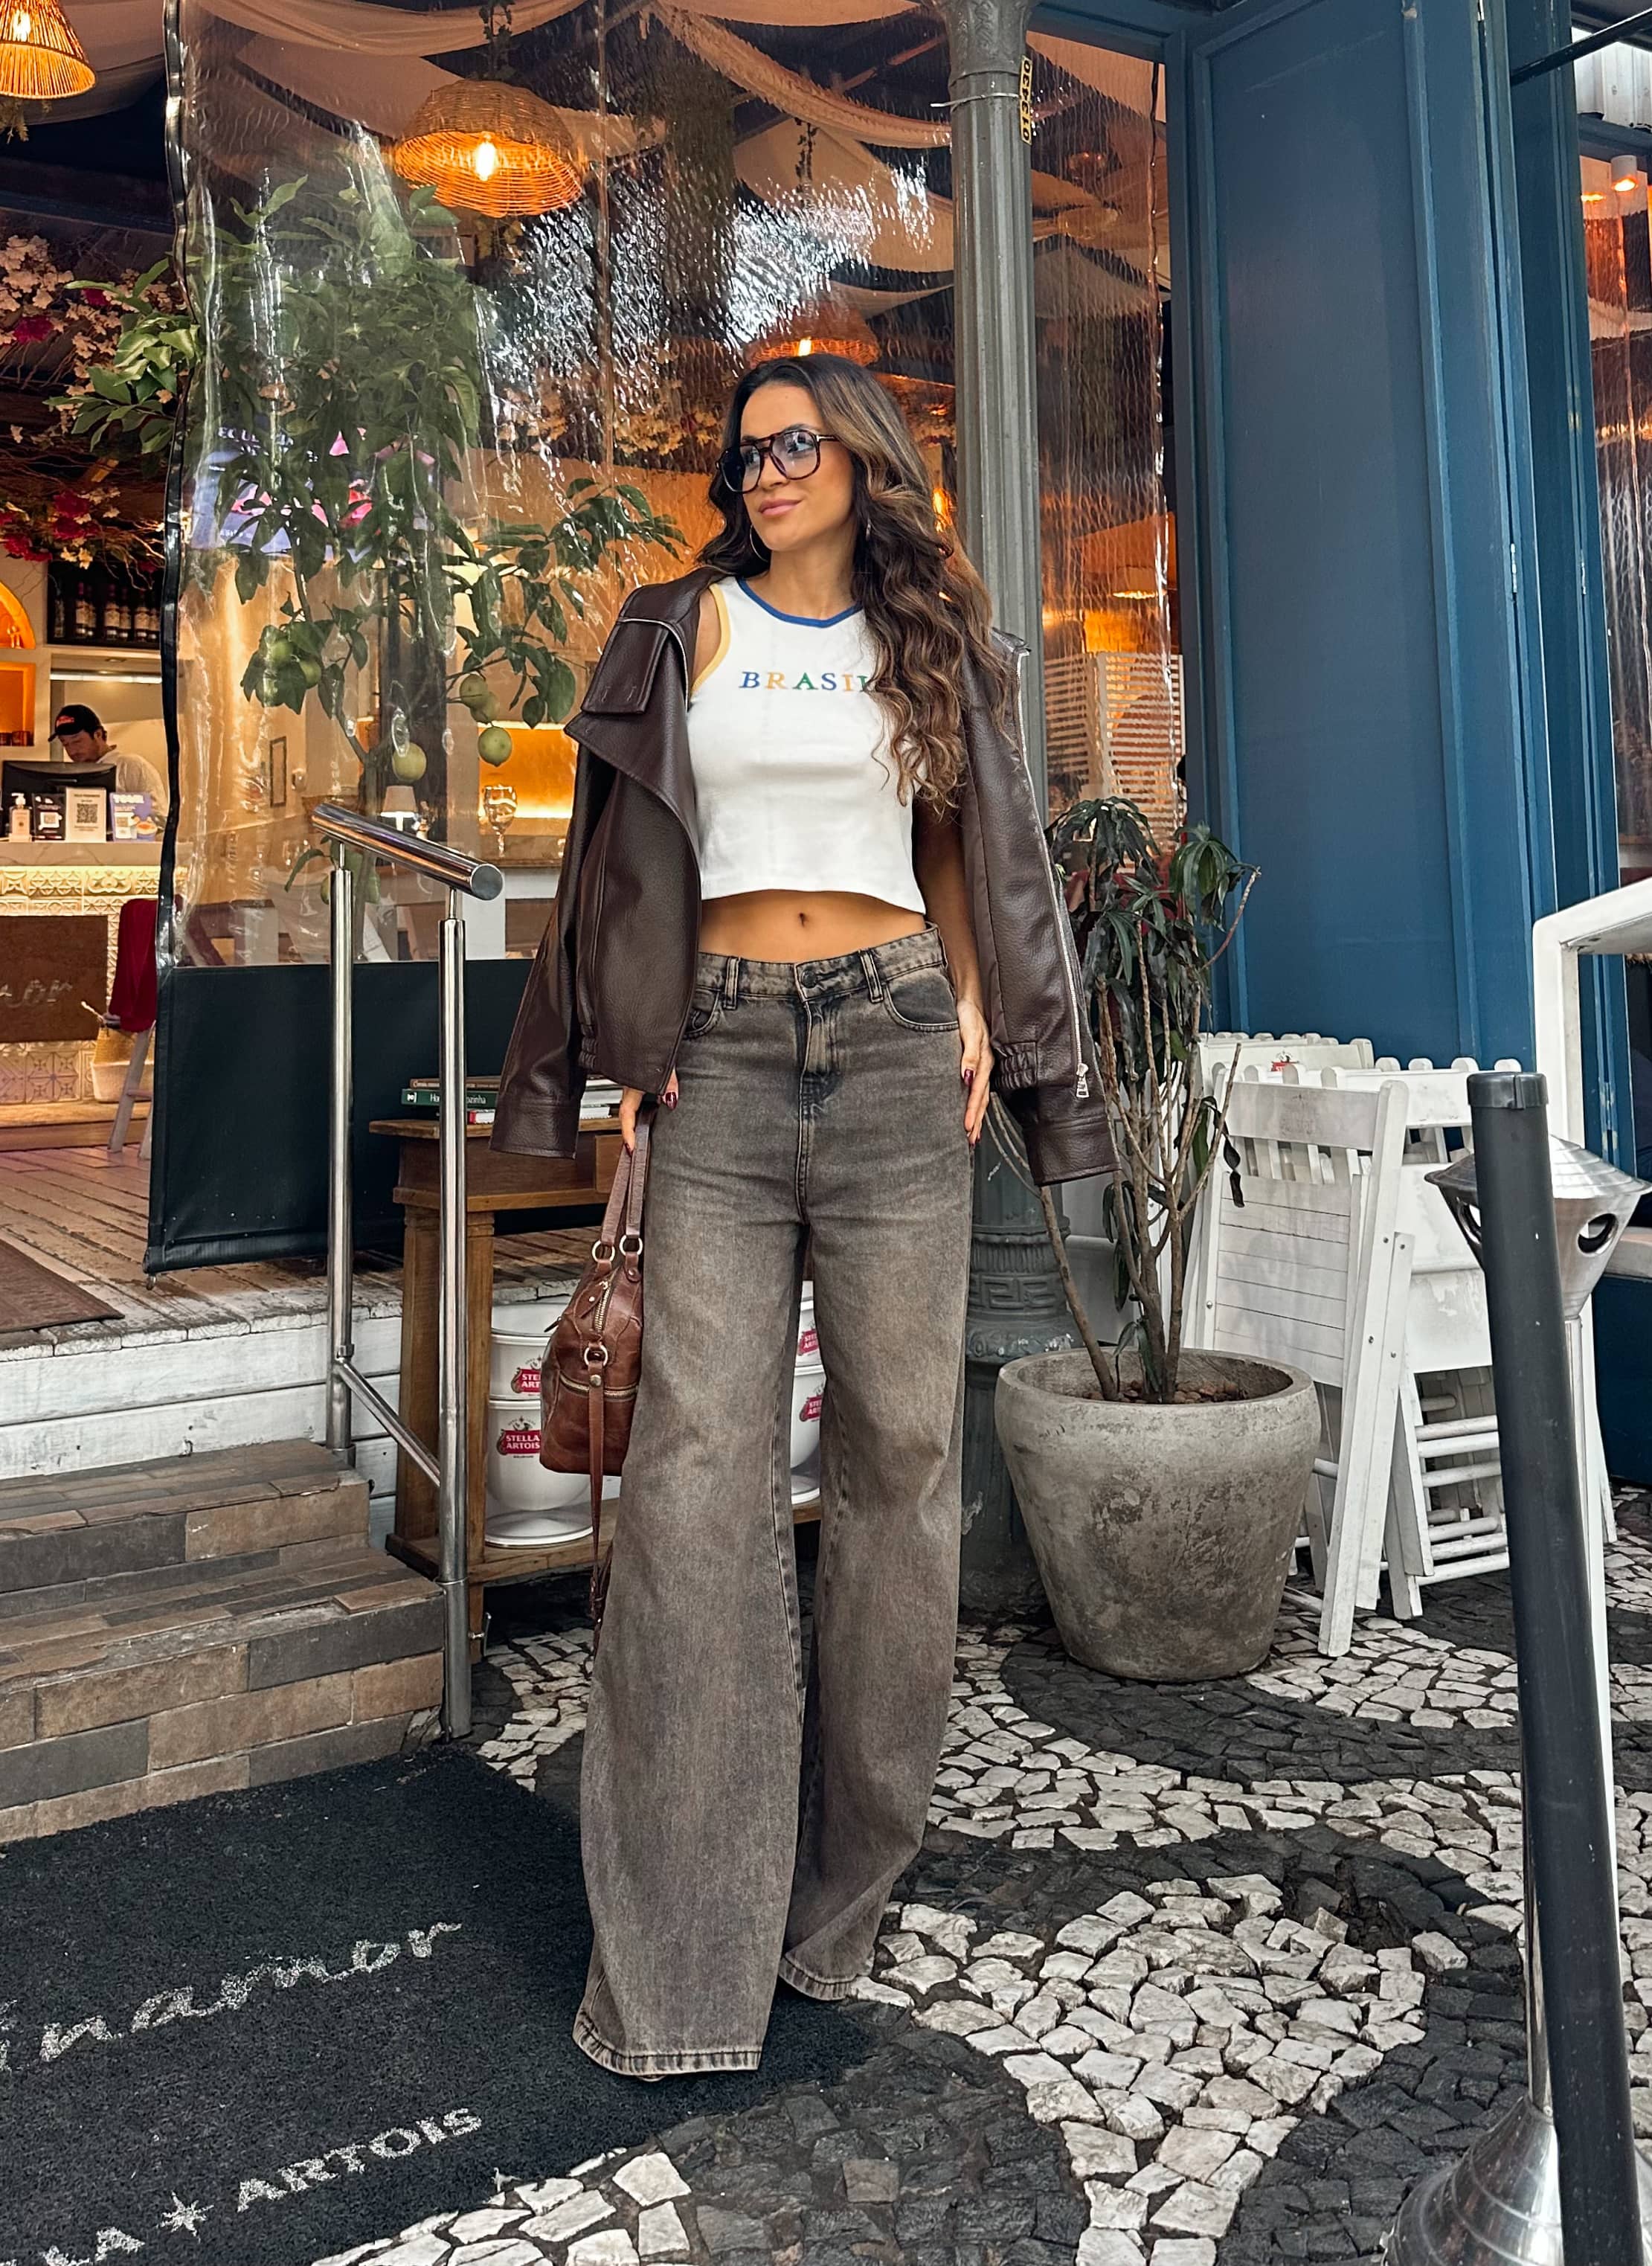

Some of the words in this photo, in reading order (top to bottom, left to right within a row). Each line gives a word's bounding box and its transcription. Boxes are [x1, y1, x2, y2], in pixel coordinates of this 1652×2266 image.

[1022, 60, 1030, 141] 013430
[466, 1094, 486, 1104] ozinha
[237, 2108, 482, 2212] ARTOIS
